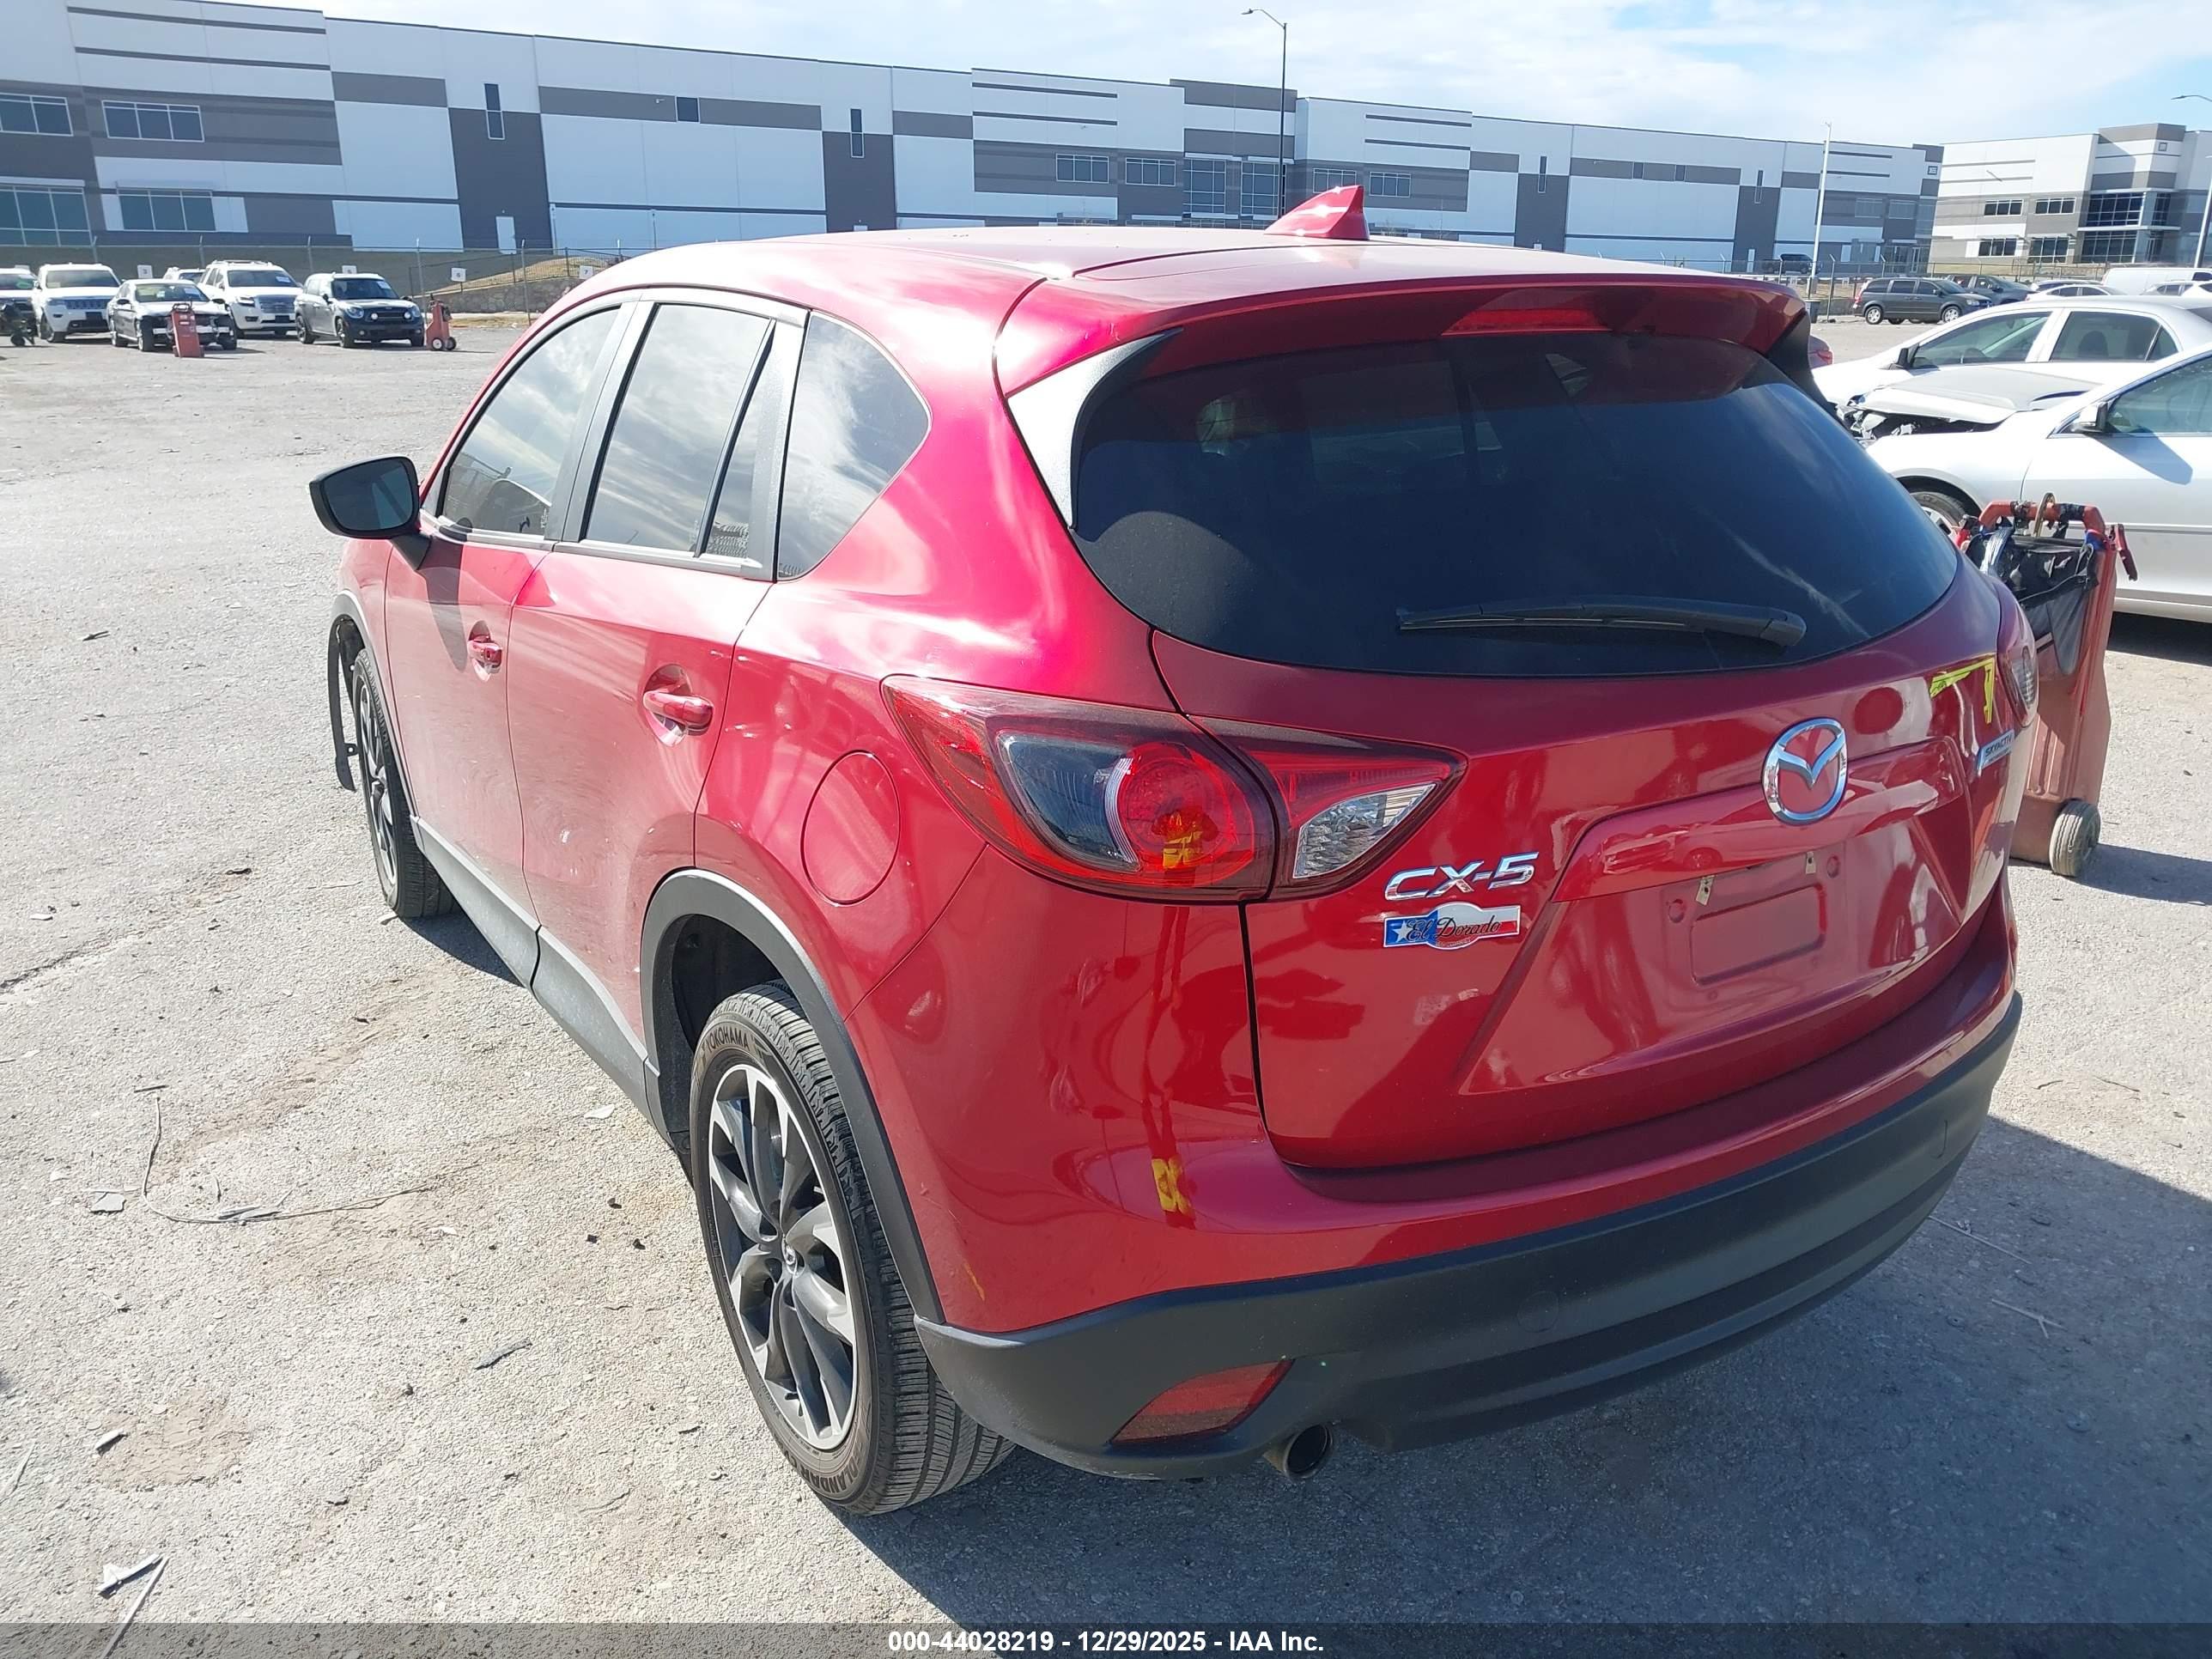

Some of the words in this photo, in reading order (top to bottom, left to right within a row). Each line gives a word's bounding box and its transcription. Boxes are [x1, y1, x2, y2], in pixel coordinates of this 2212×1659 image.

[1384, 851, 1540, 901] CX-5
[1406, 918, 1434, 942] El
[1434, 915, 1501, 938] Dorado
[706, 1027, 750, 1054] YOKOHAMA
